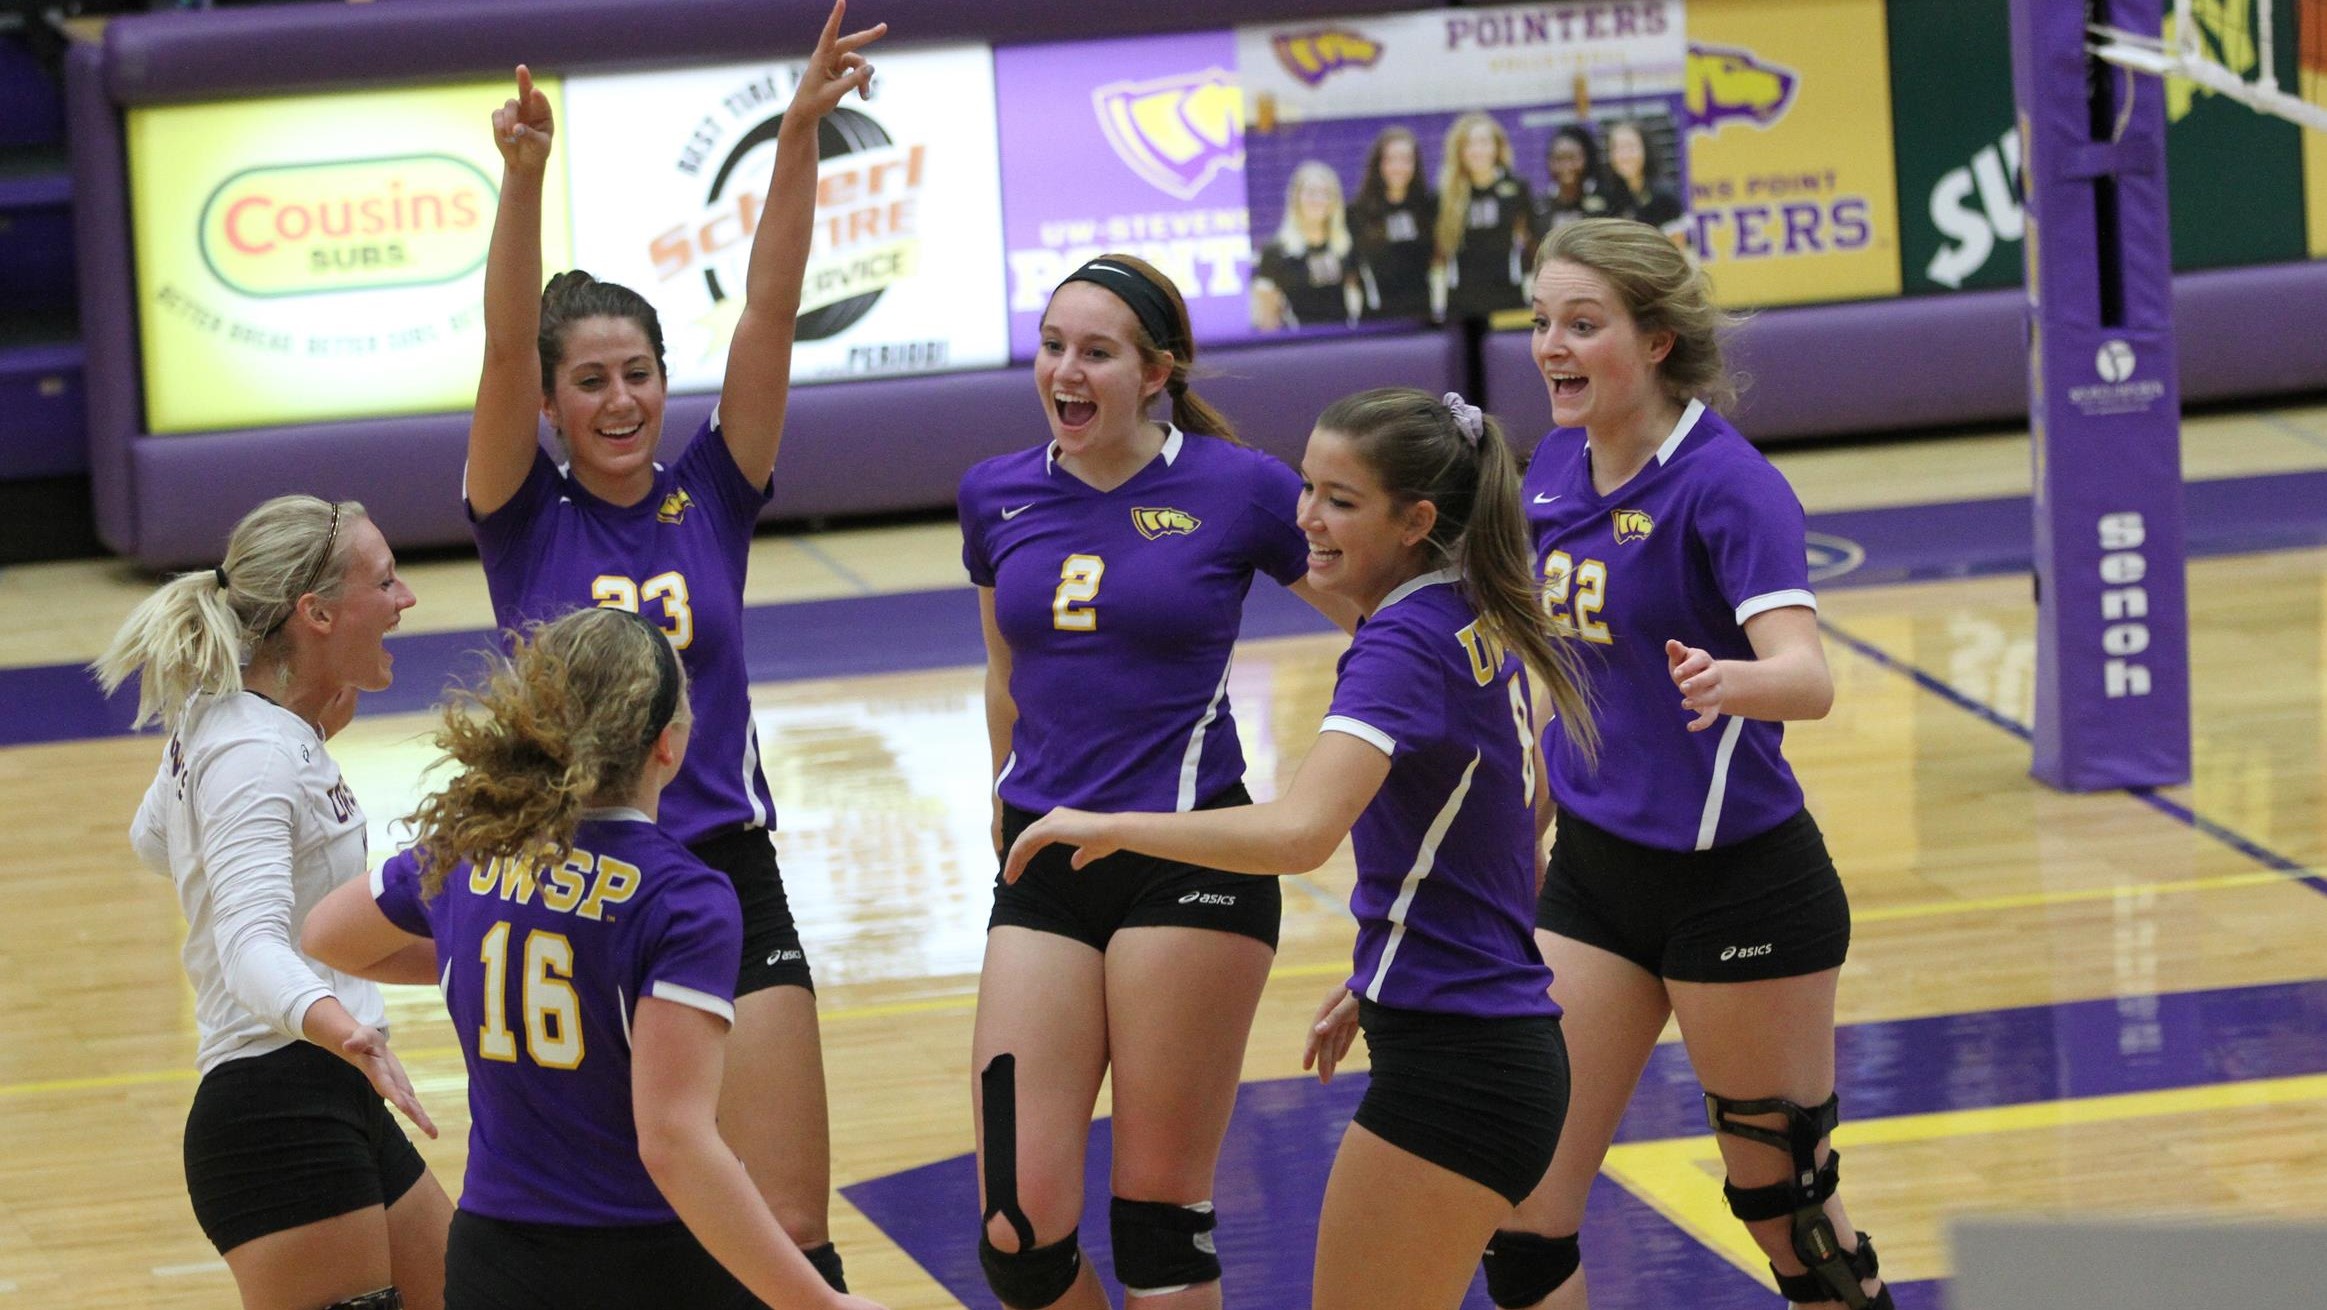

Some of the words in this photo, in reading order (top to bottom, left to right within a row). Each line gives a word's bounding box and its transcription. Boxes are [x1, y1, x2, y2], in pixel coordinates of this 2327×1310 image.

[1446, 2, 1668, 49] POINTERS
[223, 180, 480, 255] Cousins
[311, 244, 408, 271] SUBS
[1009, 234, 1251, 313] PNT
[1053, 554, 1105, 631] 2
[1542, 549, 1614, 645] 22
[2097, 511, 2151, 698] Senoh
[468, 842, 643, 922] UWSP
[1199, 893, 1236, 906] asics
[1737, 943, 1773, 958] asics
[479, 921, 586, 1071] 16
